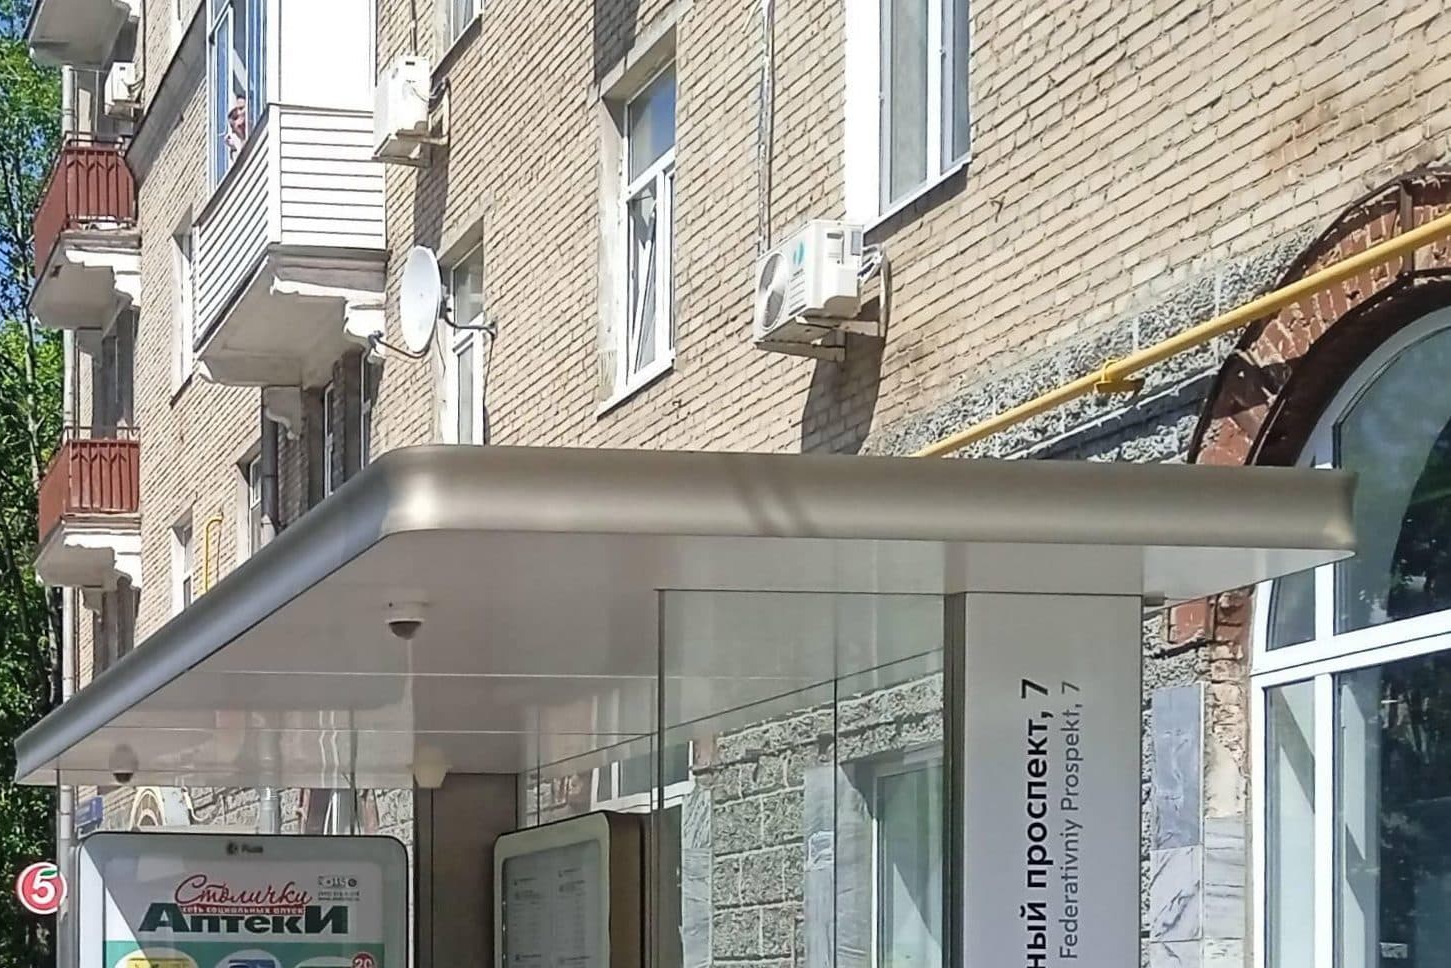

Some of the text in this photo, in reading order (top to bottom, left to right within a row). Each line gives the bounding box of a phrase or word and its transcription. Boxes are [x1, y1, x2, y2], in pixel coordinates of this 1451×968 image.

[1021, 679, 1050, 698] 7
[1025, 709, 1054, 889] проспект,
[1059, 680, 1084, 960] Federativniy Prospekt, 7
[31, 867, 59, 905] 5
